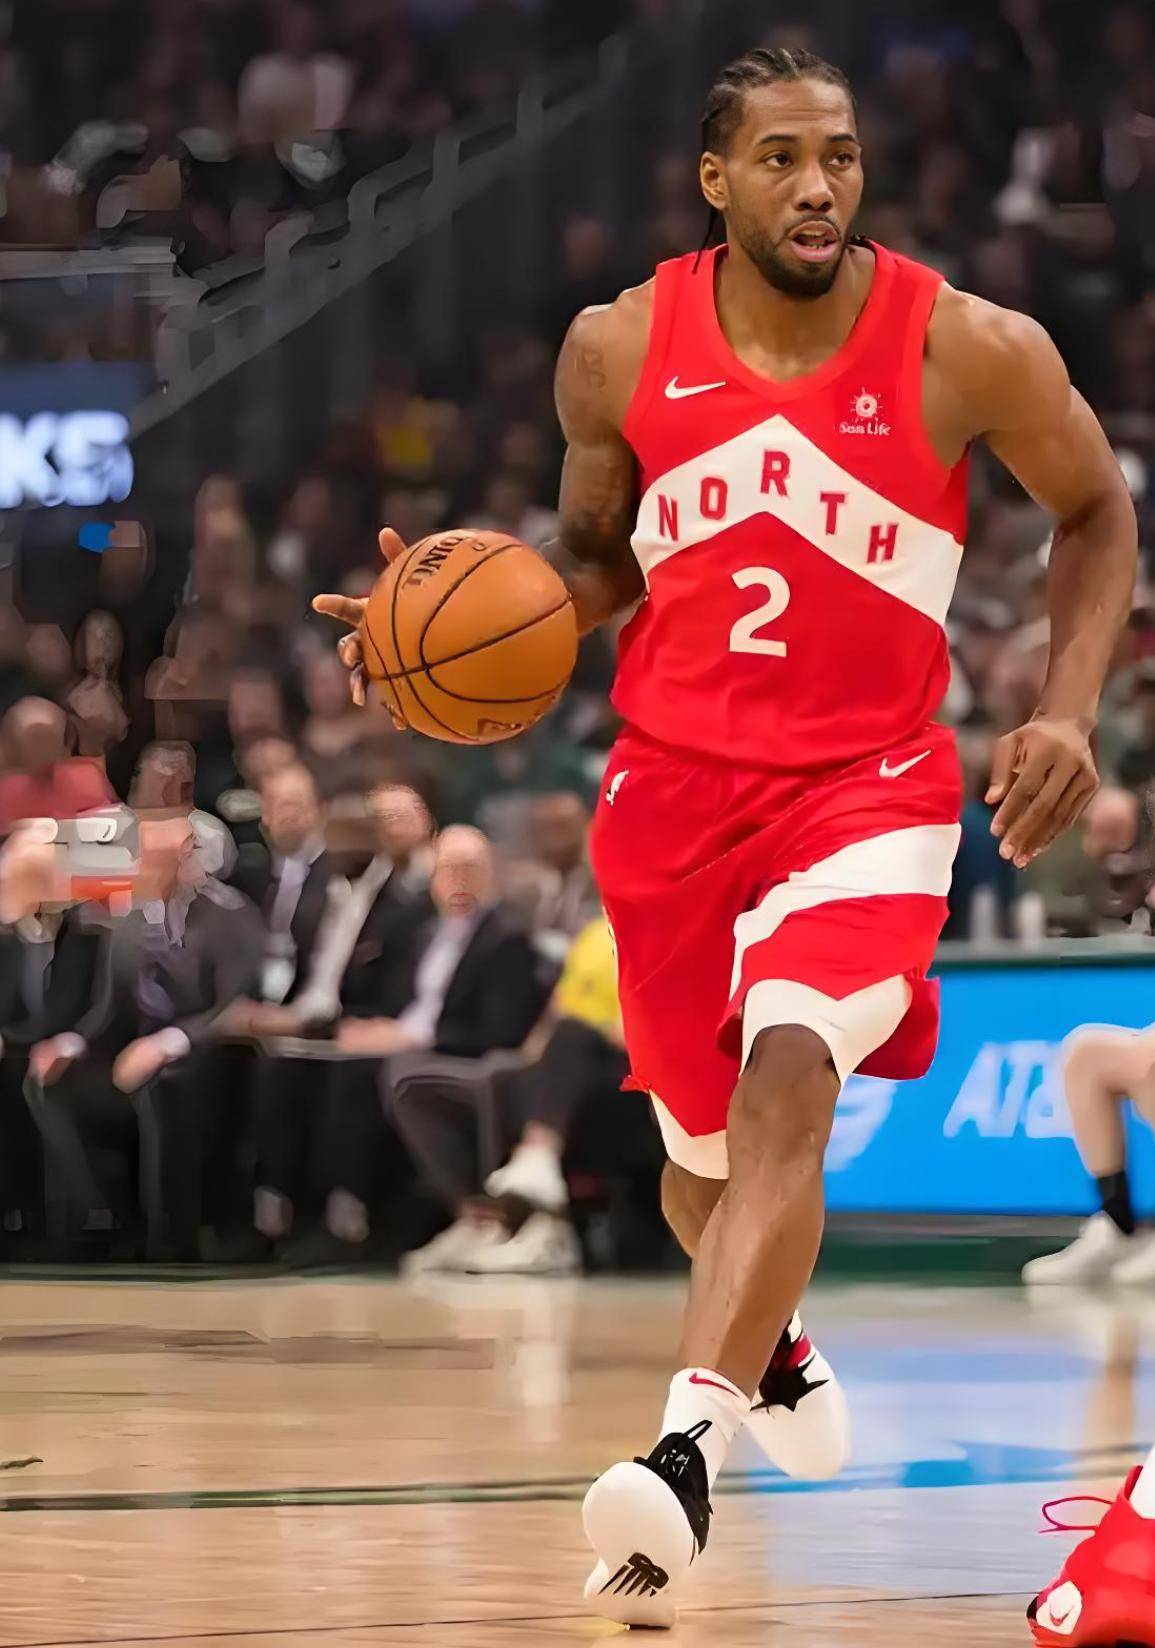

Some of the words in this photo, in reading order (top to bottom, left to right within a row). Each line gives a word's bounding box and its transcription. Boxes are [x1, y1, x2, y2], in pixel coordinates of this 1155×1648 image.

[657, 448, 900, 564] NORTH
[729, 566, 791, 658] 2
[943, 1039, 1075, 1139] AT&
